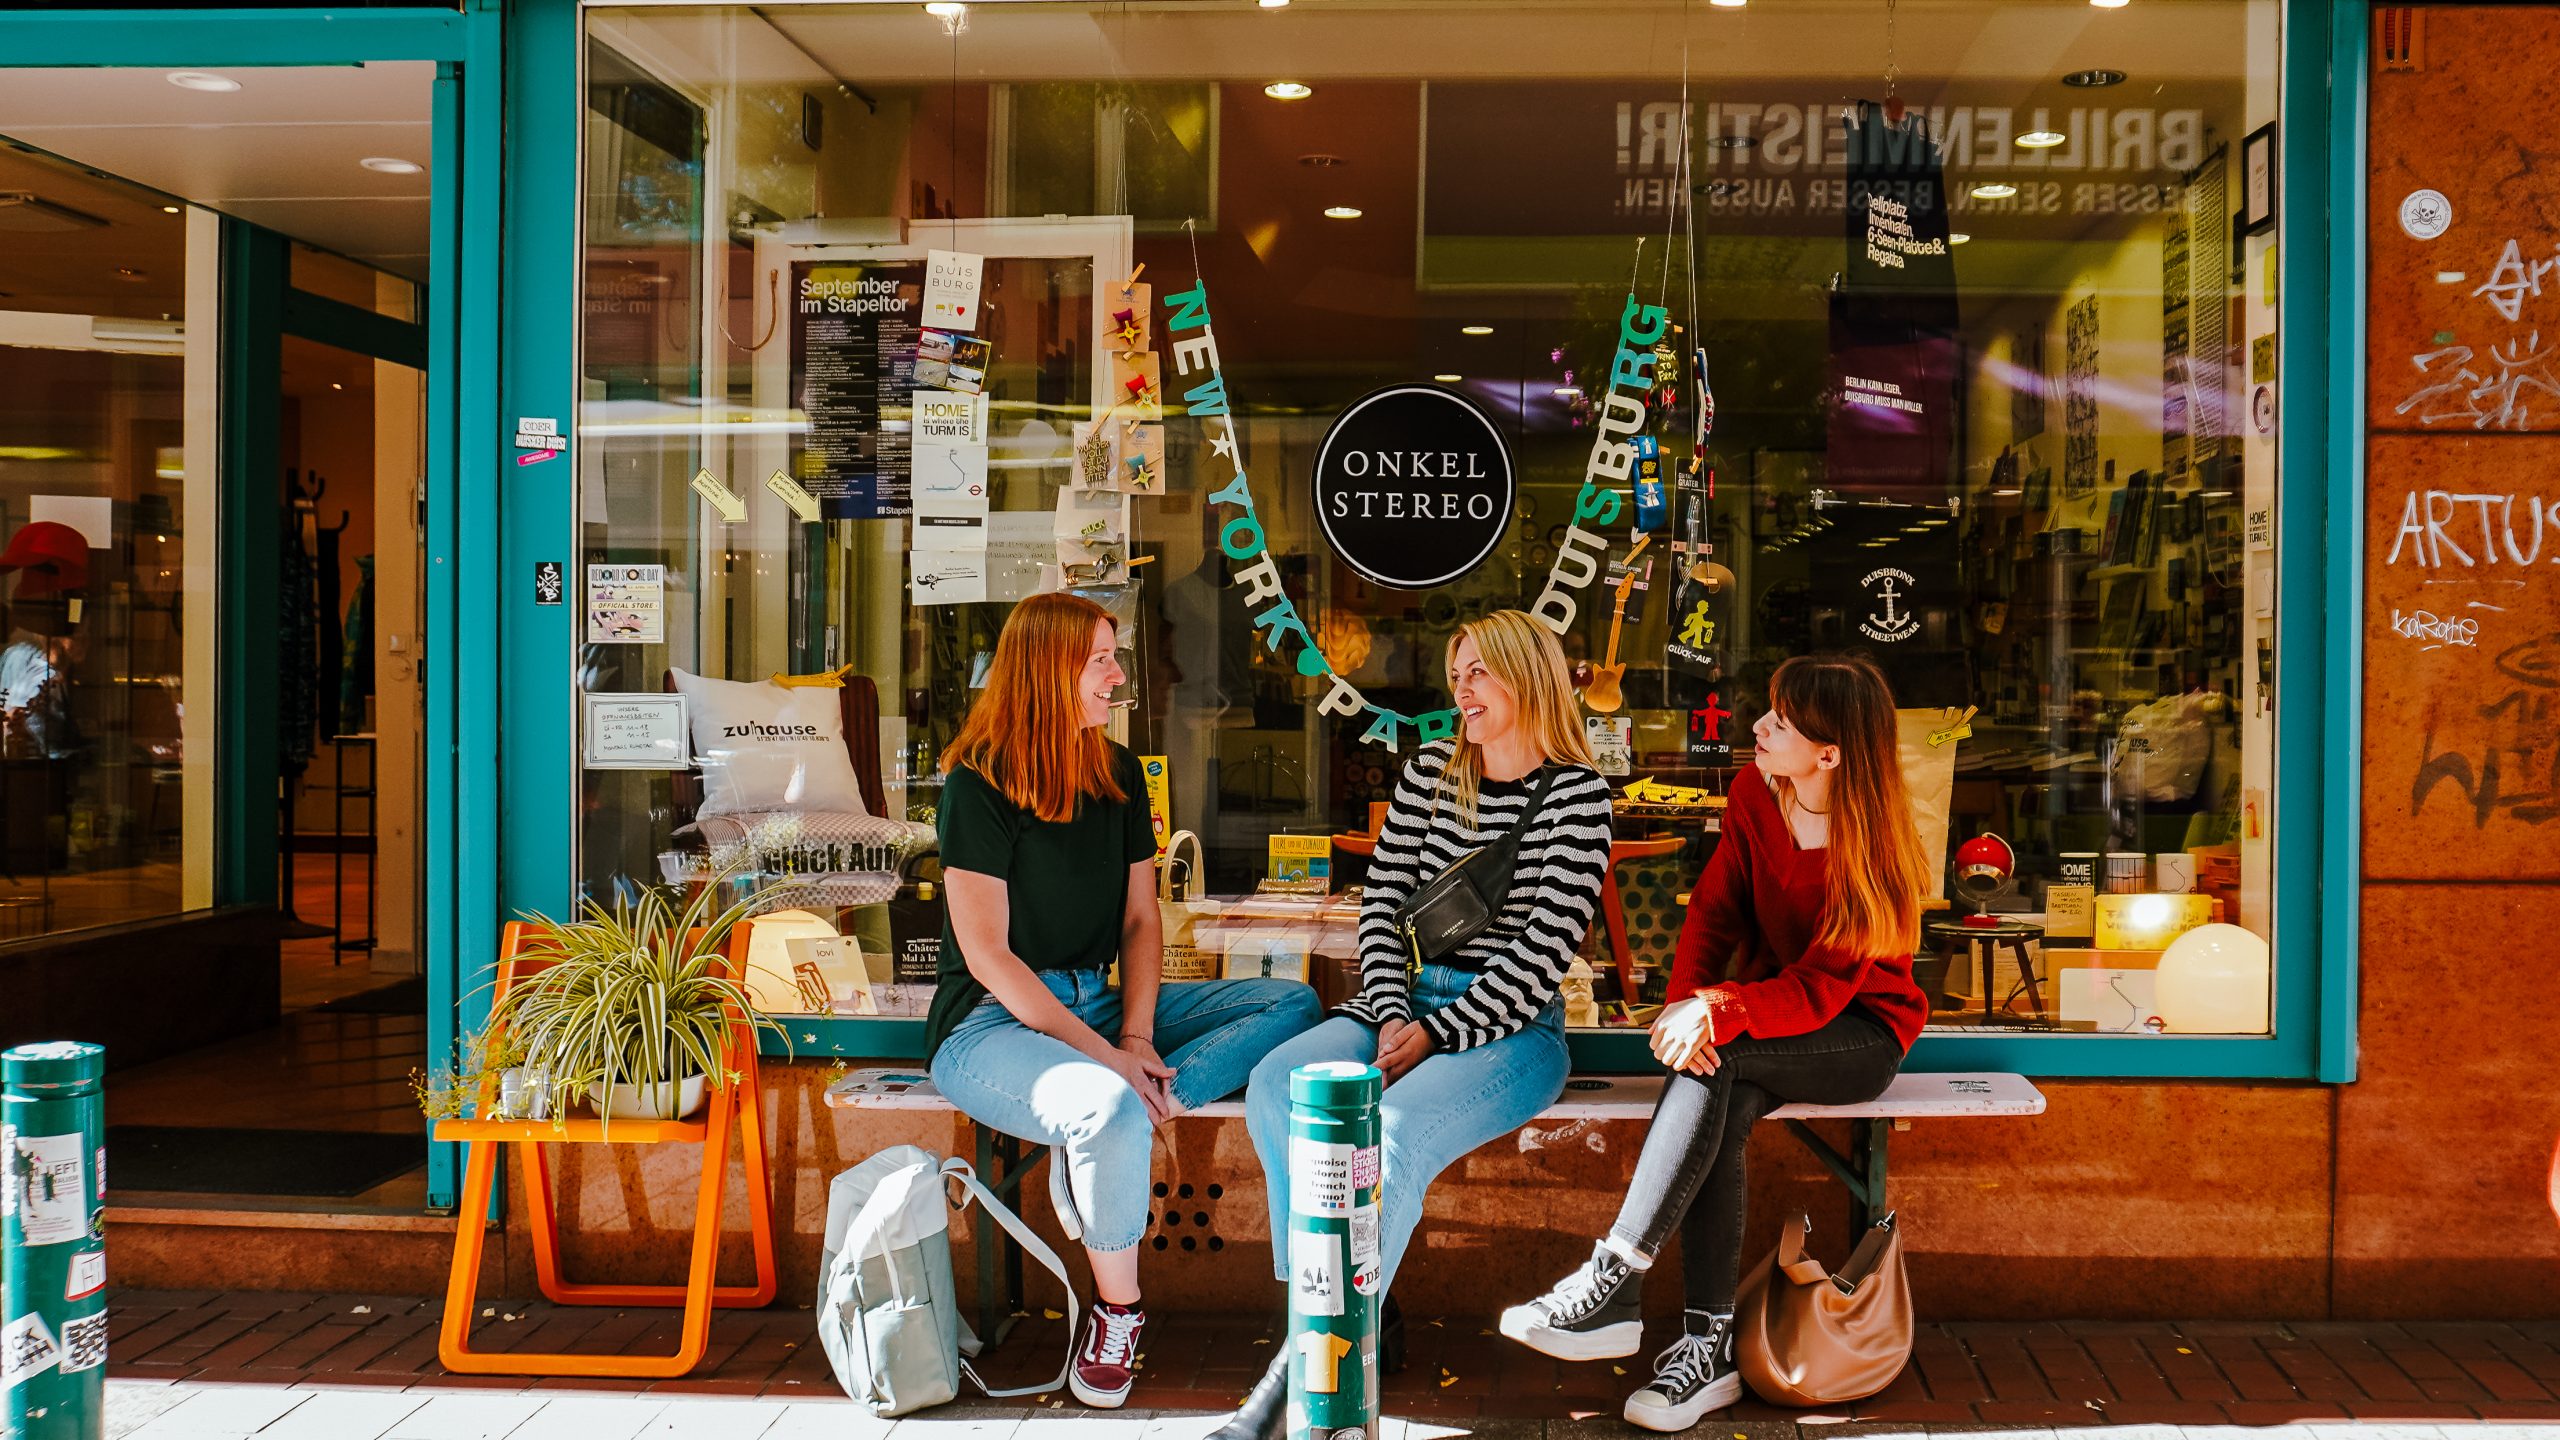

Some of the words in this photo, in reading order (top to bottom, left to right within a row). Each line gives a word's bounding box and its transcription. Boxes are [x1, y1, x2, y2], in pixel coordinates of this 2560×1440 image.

[1867, 243, 1904, 268] Regatta
[935, 265, 973, 277] DUIS
[800, 277, 900, 299] September
[932, 278, 974, 290] BURG
[800, 296, 821, 313] im
[827, 295, 910, 316] Stapeltor
[1164, 284, 1230, 417] NEW
[1660, 362, 1672, 370] TO
[1845, 376, 1867, 389] BERLIN
[1844, 390, 1874, 405] DUISBURG
[1874, 394, 1891, 407] MUSS
[924, 403, 969, 417] HOME
[523, 421, 552, 431] ODER
[923, 425, 956, 436] TURM
[959, 425, 970, 436] IS
[1343, 451, 1486, 479] ONKEL
[1530, 294, 1668, 636] DUISBURG
[1678, 479, 1699, 488] GRATER
[1332, 491, 1493, 520] STEREO
[2249, 510, 2267, 525] HOME
[1208, 471, 1307, 653] YORK
[646, 569, 660, 581] DAY
[1860, 567, 1916, 588] DUISBRONX
[1859, 621, 1921, 642] STREETWEAR
[723, 720, 817, 738] zuhause
[1691, 744, 1710, 753] PECH
[1718, 744, 1729, 753] ZU
[2060, 863, 2091, 876] HOME
[907, 943, 941, 952] Châtea
[1163, 948, 1198, 957] Château
[902, 953, 918, 962] Mal
[928, 953, 937, 962] la
[1180, 959, 1189, 967] la
